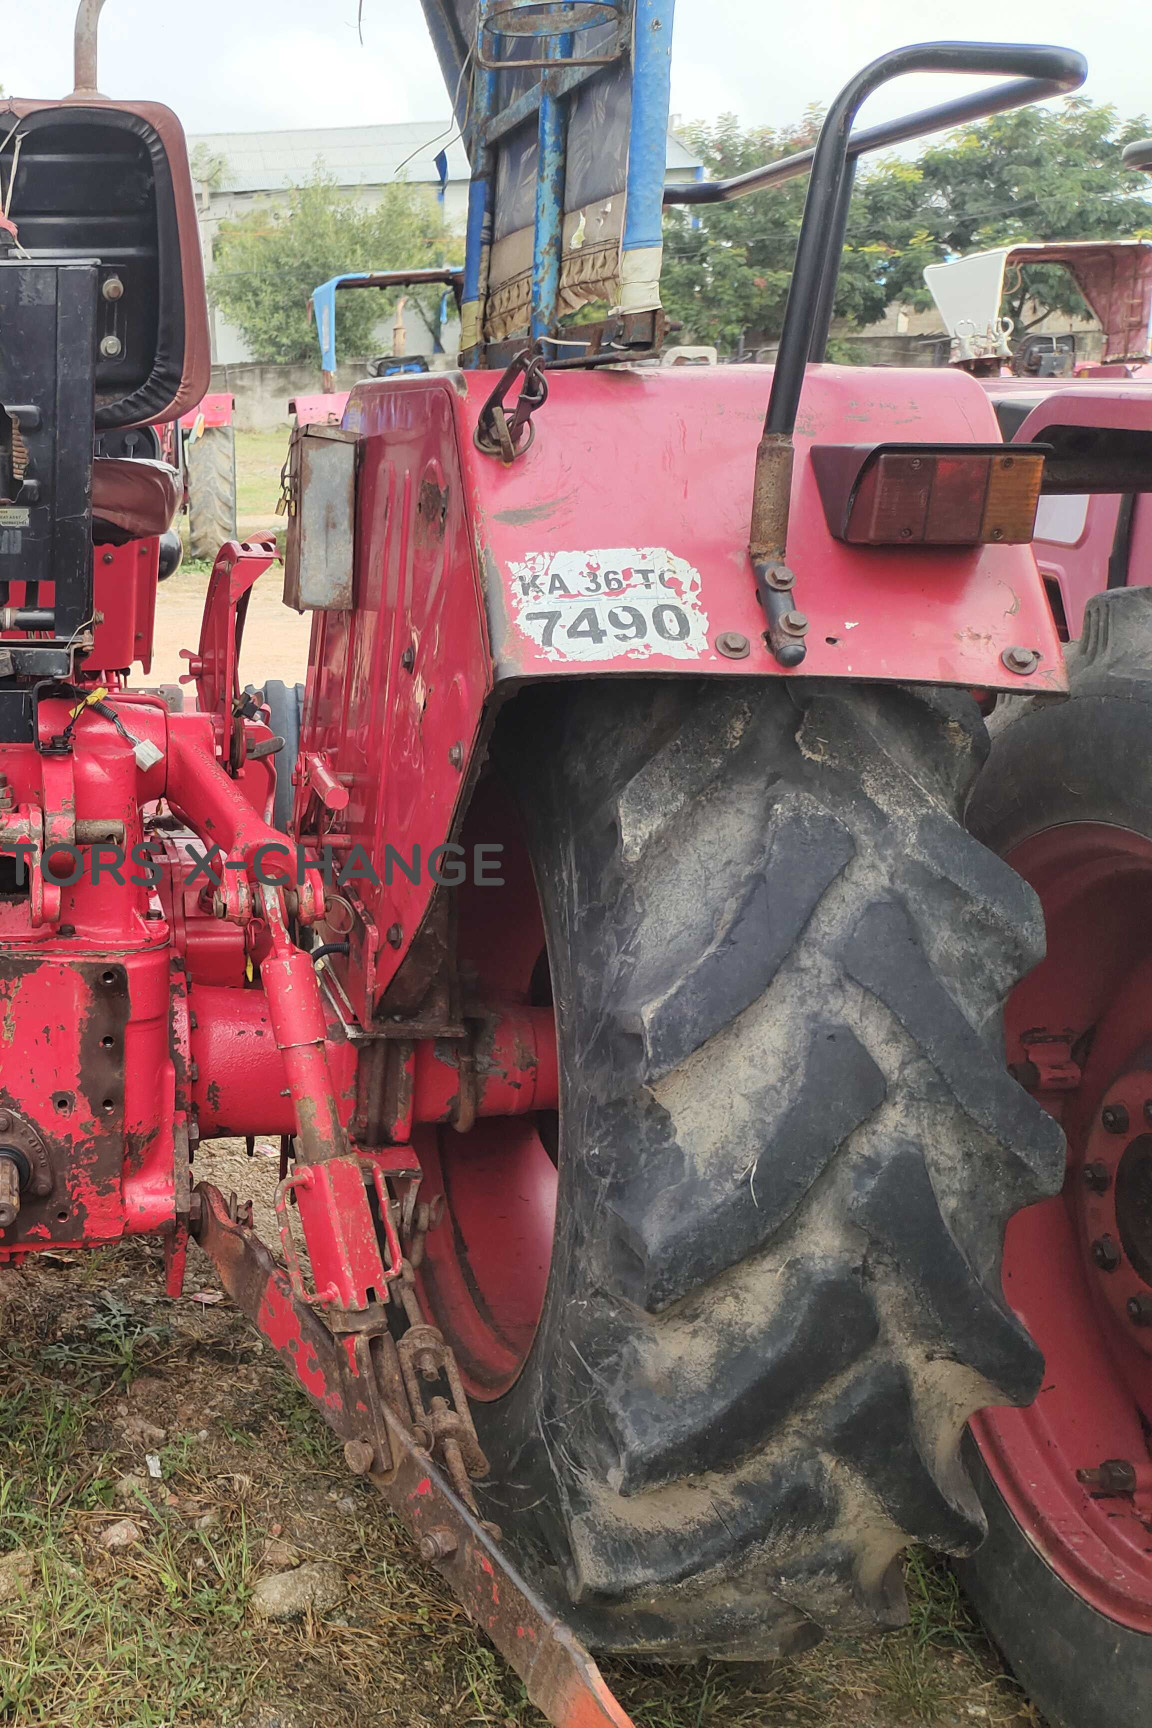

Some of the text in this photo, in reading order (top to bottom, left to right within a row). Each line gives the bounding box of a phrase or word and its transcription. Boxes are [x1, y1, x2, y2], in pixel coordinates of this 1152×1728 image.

[518, 573, 571, 596] KA
[581, 570, 624, 593] 36
[525, 603, 691, 647] 7490
